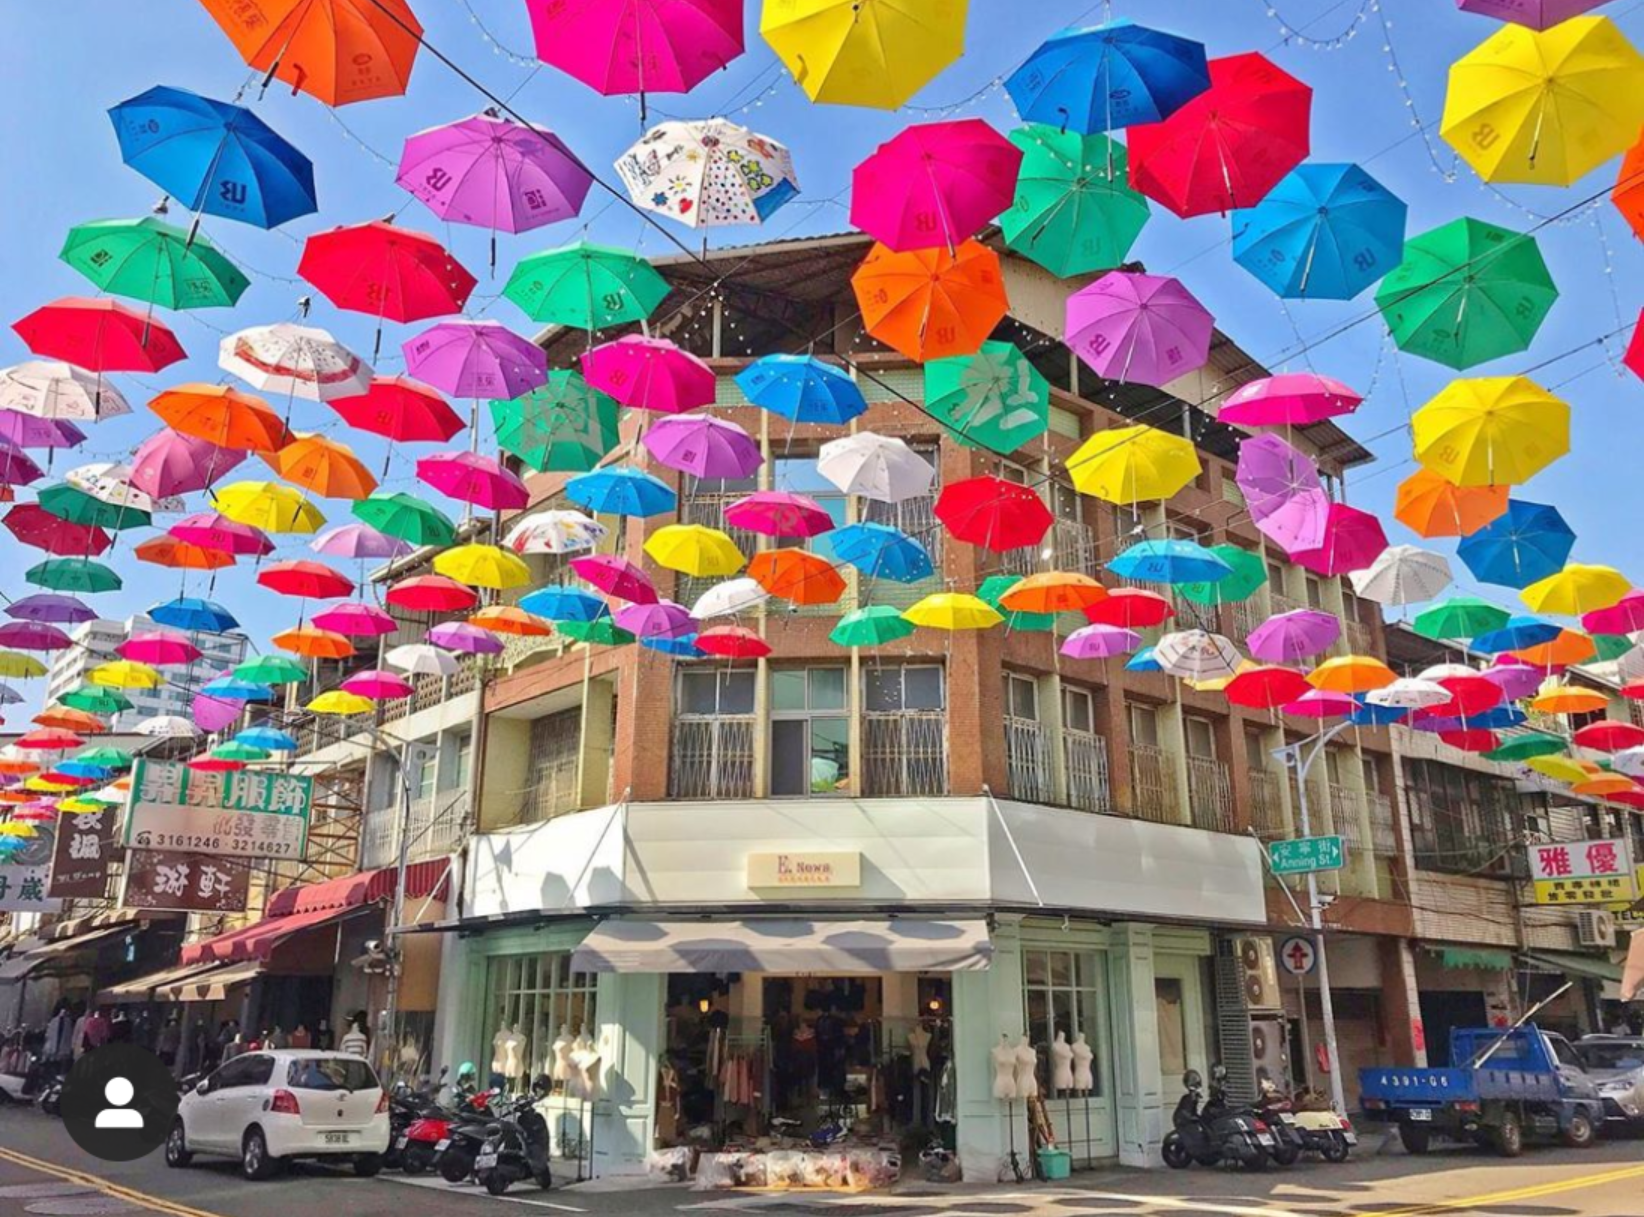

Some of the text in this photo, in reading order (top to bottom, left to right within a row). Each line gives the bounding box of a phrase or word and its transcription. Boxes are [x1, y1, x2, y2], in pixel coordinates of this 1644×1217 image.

[156, 834, 291, 855] 3161246 3214627
[1280, 857, 1316, 870] Anning
